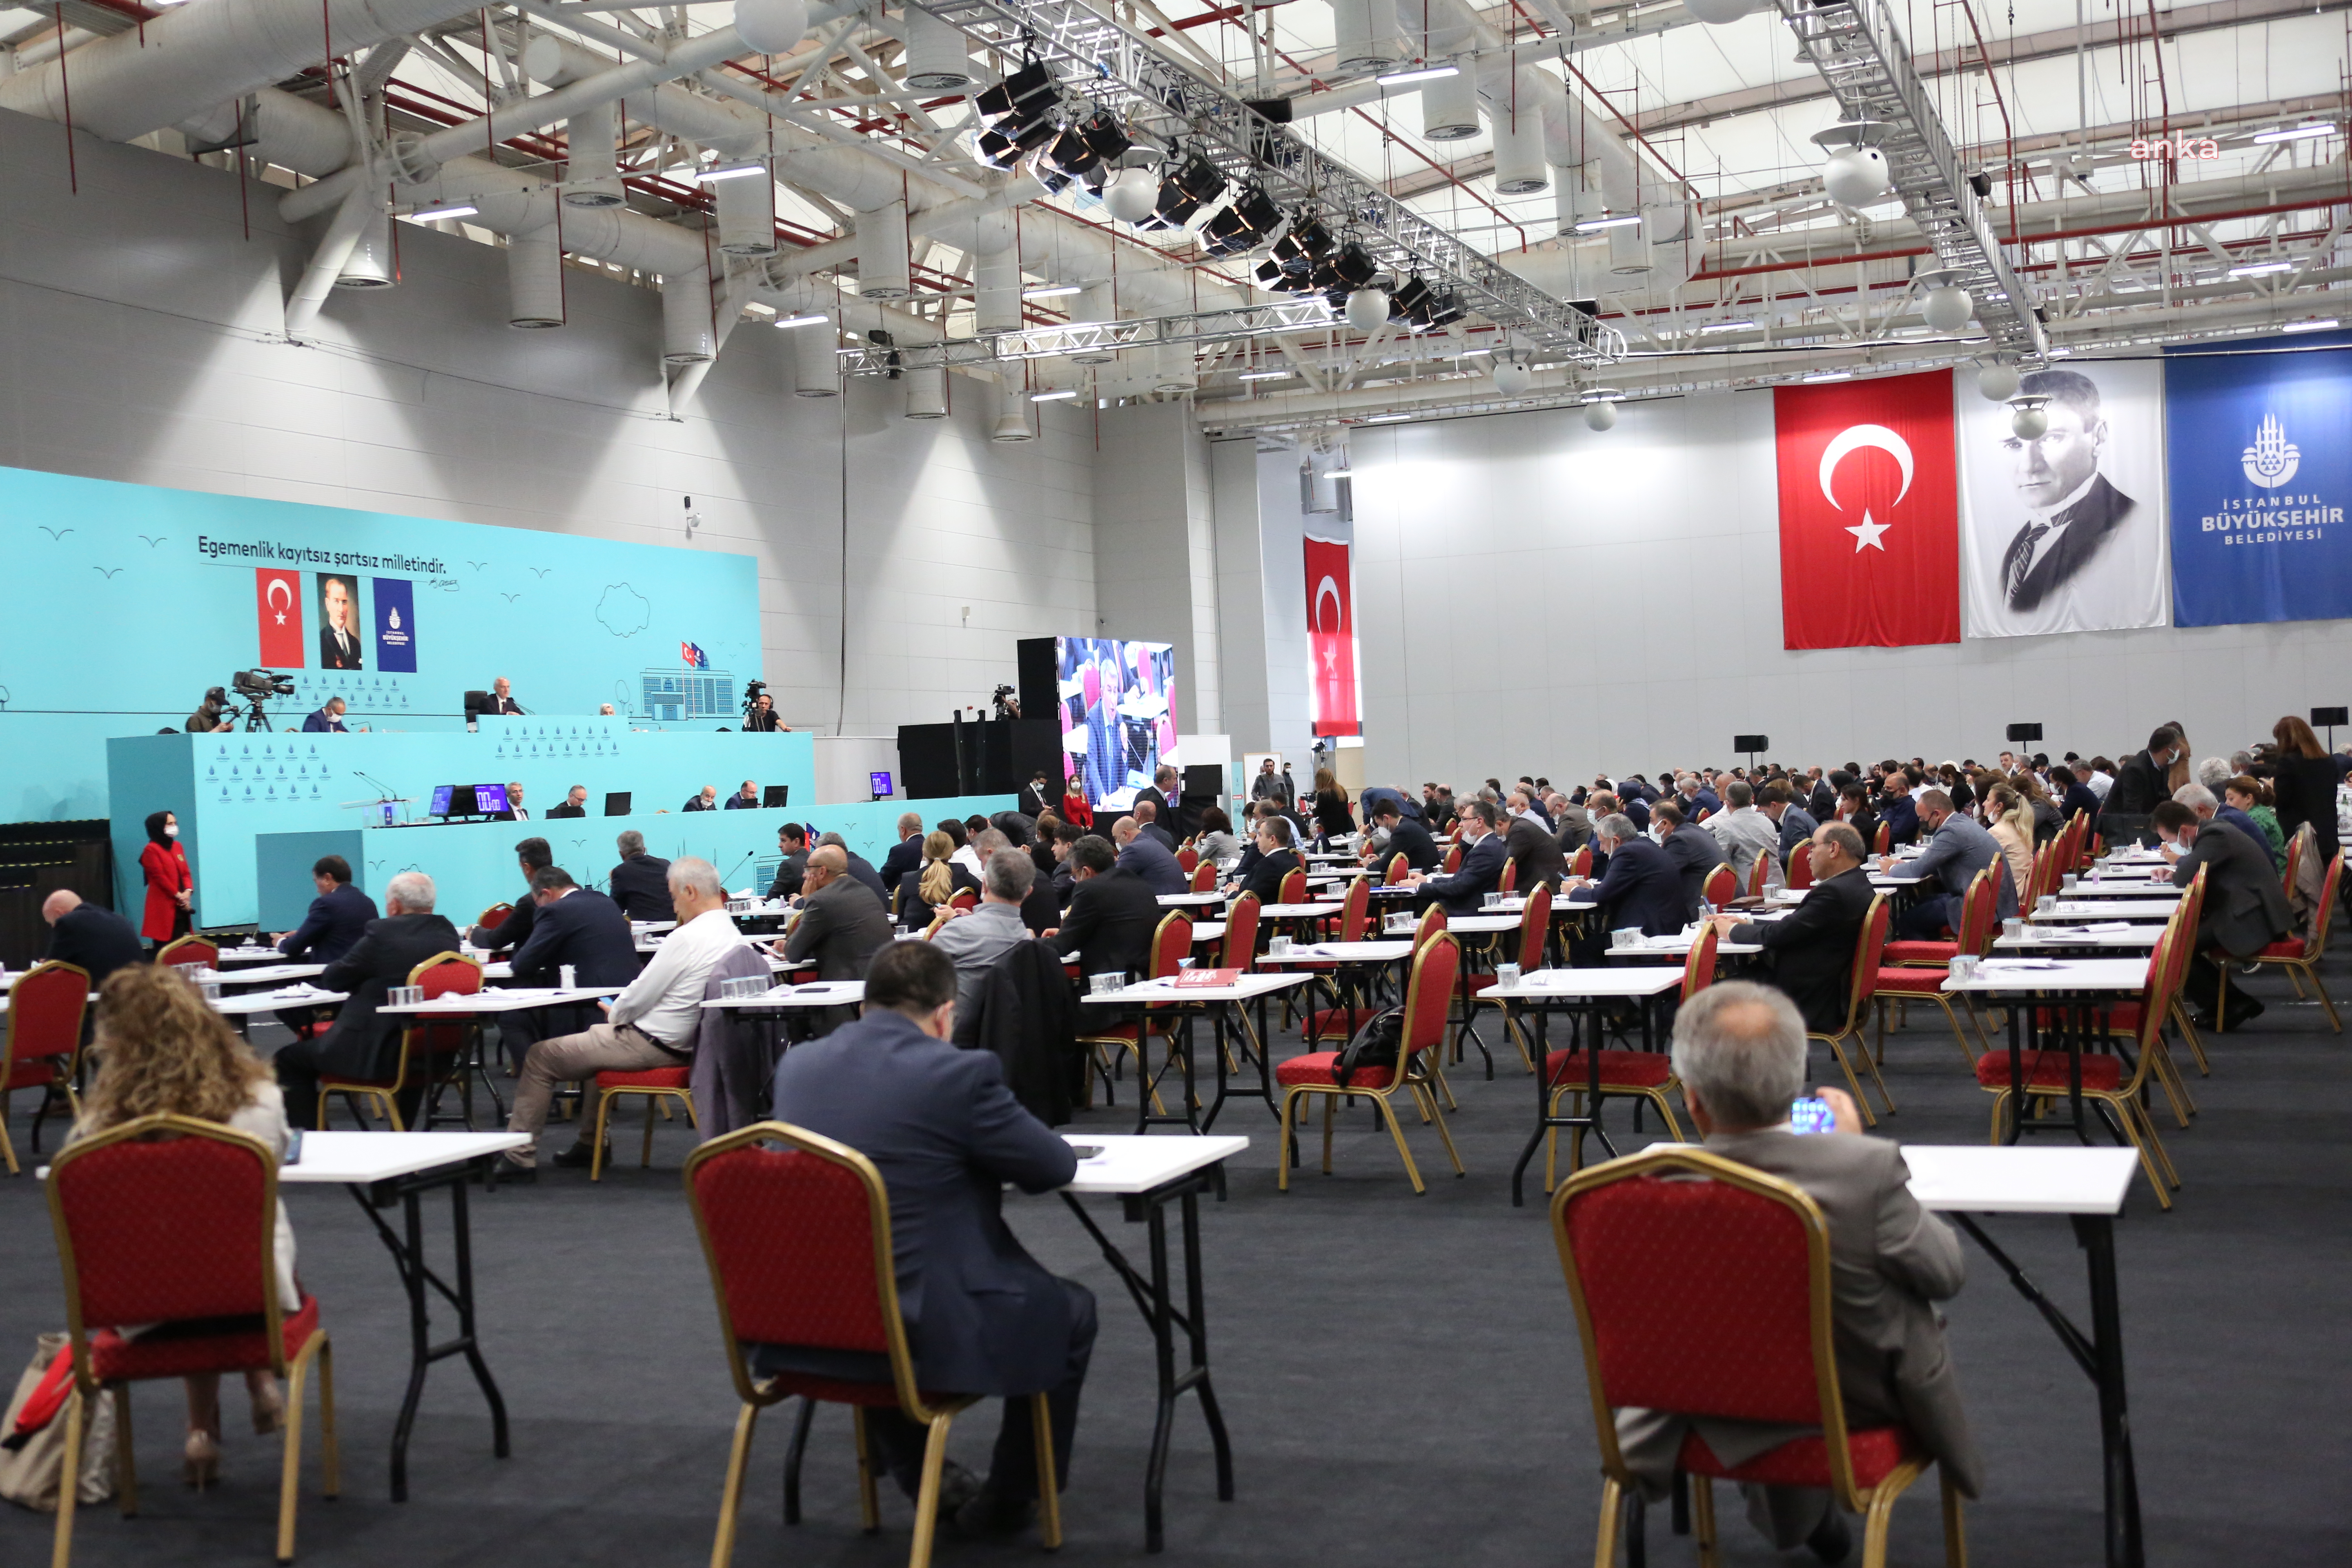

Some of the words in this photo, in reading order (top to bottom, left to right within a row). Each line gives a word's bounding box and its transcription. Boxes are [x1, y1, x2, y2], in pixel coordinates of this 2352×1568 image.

[2223, 494, 2321, 510] İSTANBUL
[2201, 505, 2344, 532] BÜYÜKŞEHİR
[2224, 528, 2322, 545] BELEDİYESİ
[198, 535, 275, 558] Egemenlik
[277, 542, 330, 565] kayıtsız
[334, 551, 379, 567] şartsız
[382, 554, 446, 574] milletindir.
